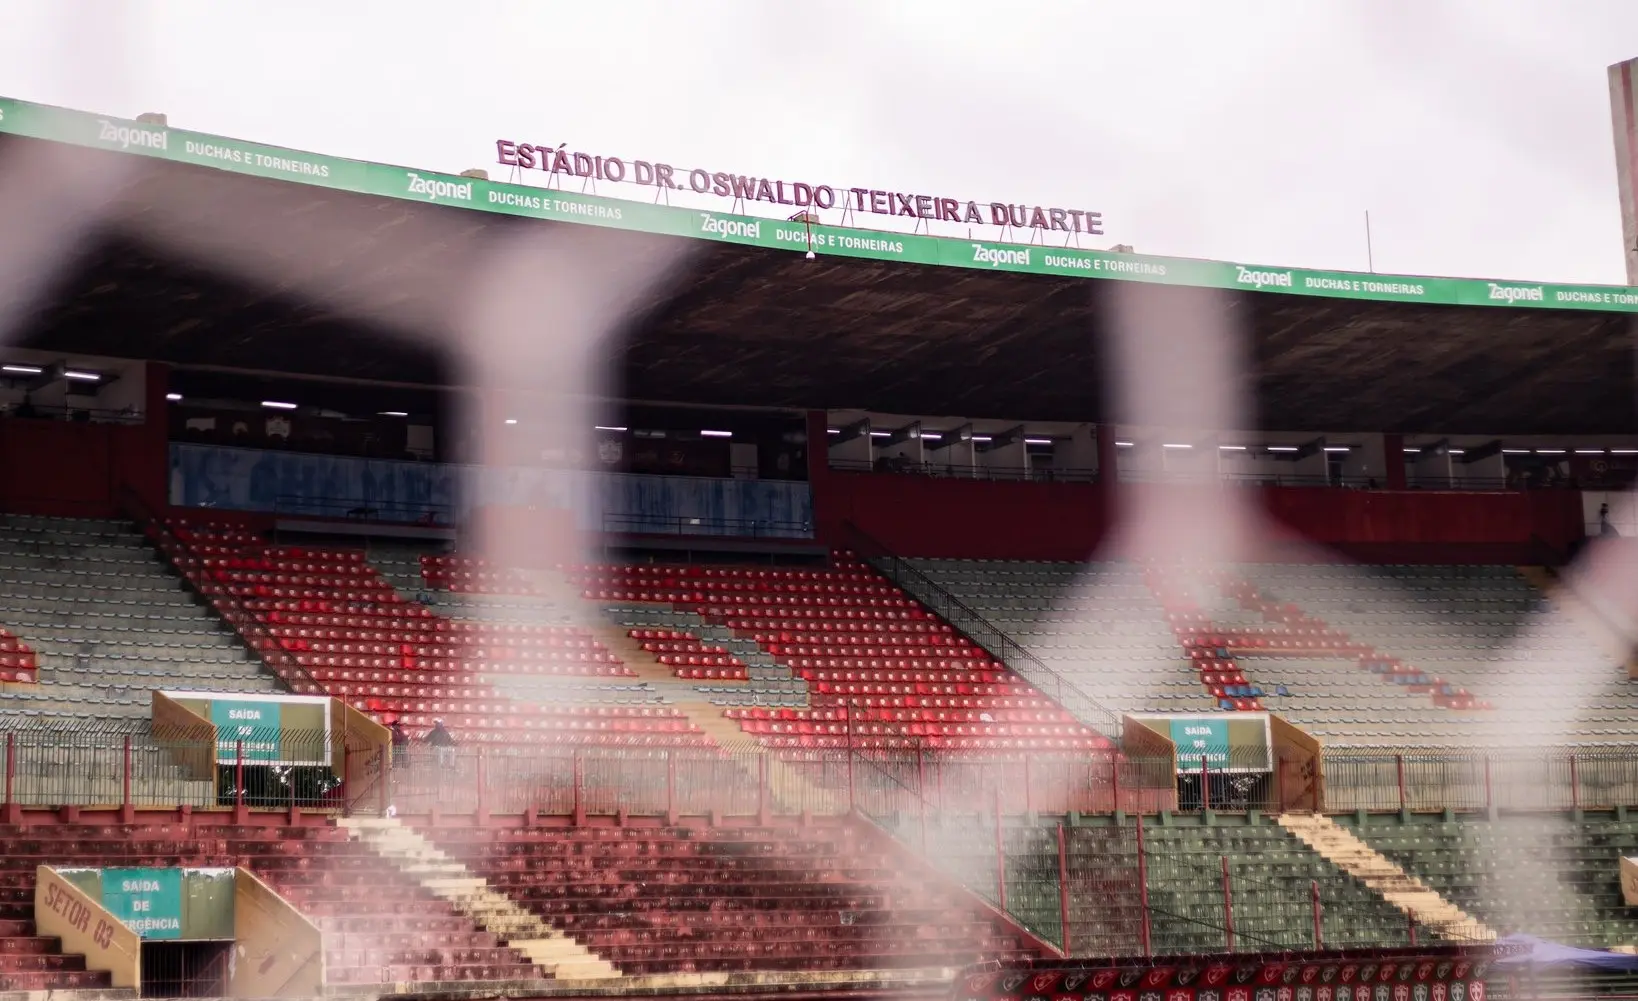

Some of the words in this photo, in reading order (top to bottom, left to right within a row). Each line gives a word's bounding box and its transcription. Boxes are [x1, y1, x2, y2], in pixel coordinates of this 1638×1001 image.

[97, 119, 167, 150] Zagonel
[186, 141, 241, 162] DUCHAS
[245, 152, 251, 164] E
[256, 154, 328, 177] TORNEIRAS
[407, 173, 472, 200] Zagonel
[497, 139, 625, 182] ESTÁDIO
[635, 160, 684, 190] DR.
[690, 168, 835, 209] OSWALDO
[850, 187, 983, 224] TEIXEIRA
[990, 202, 1104, 235] DUARTE
[489, 190, 540, 209] DUCHAS
[544, 198, 550, 210] E
[554, 200, 622, 219] TORNEIRAS
[701, 213, 761, 239] Zagonel
[776, 228, 825, 245] DUCHAS
[828, 235, 835, 246] E
[838, 236, 903, 253] TORNEIRAS
[972, 244, 1030, 267] Zagonel
[1045, 255, 1091, 270] DUCHAS
[1095, 259, 1101, 270] E
[1104, 260, 1166, 276] TORNEIRAS
[1236, 266, 1292, 288] Zagonel
[1306, 277, 1350, 291] DUCHAS
[1353, 280, 1360, 291] E
[1362, 281, 1423, 295] TORNEIRAS
[1488, 283, 1543, 303] Zagonel
[1557, 291, 1602, 303] DUCHAS
[1604, 293, 1611, 303] E
[229, 709, 261, 720] SAÍDA
[1184, 726, 1212, 736] SAÍDA
[122, 880, 160, 892] SAÍDA
[43, 882, 91, 934] SETOR
[94, 919, 114, 950] 03
[133, 900, 150, 912] DE
